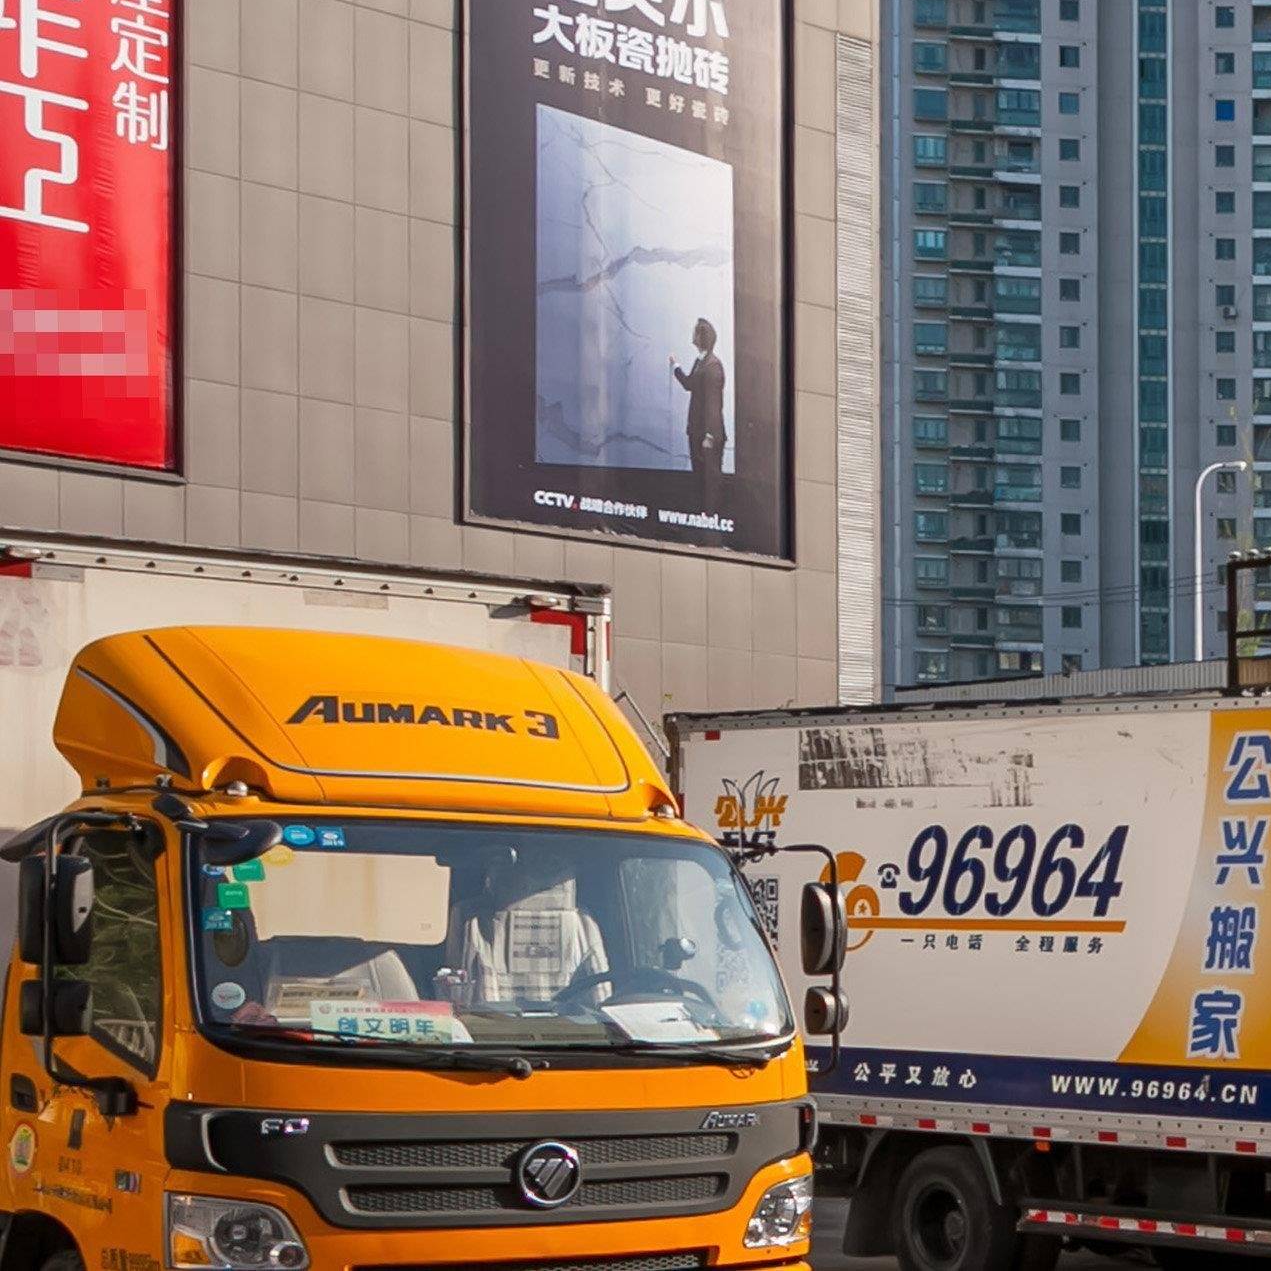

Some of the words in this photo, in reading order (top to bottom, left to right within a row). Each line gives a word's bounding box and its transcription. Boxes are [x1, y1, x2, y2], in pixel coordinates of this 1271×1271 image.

[532, 4, 730, 95] 大板瓷抛砖
[533, 57, 627, 98] 更新技术
[534, 490, 574, 509] CCTV
[285, 695, 517, 734] AUMARK
[524, 709, 560, 740] 3
[899, 823, 1130, 918] 96964
[900, 934, 984, 951] 一只电话
[1014, 935, 1104, 955] 全程服务
[852, 1061, 979, 1089] 公平又放心
[1050, 1073, 1259, 1105] WWW.96964.CN
